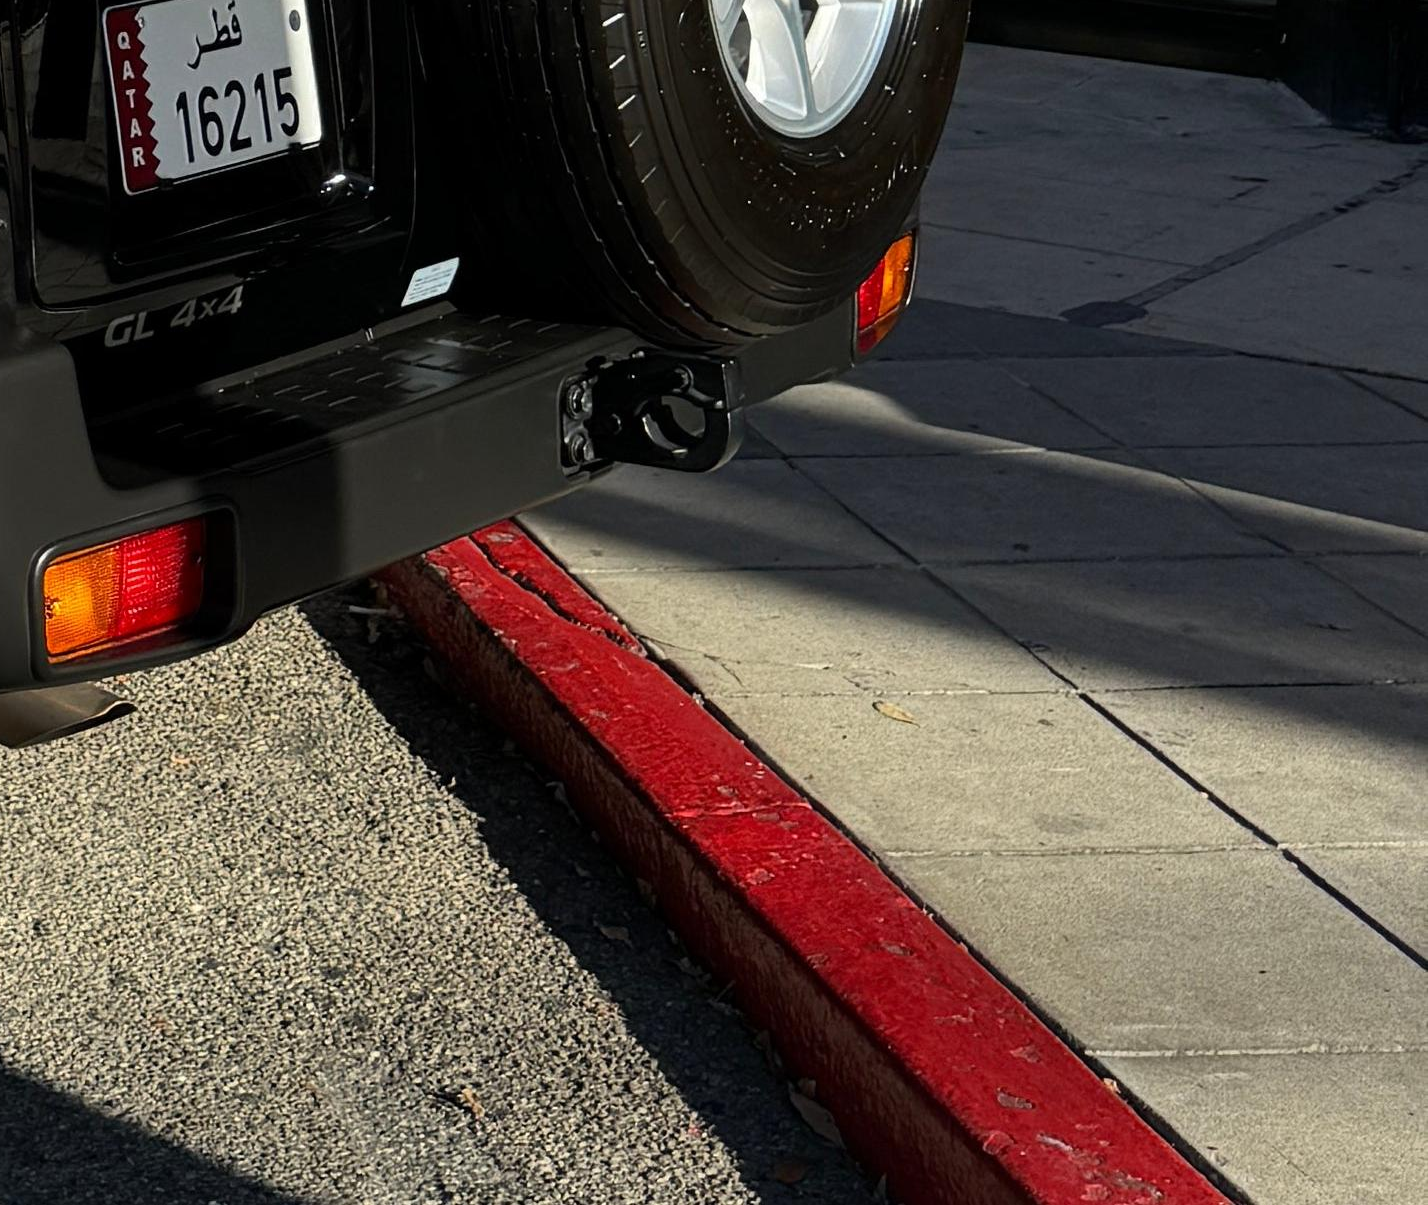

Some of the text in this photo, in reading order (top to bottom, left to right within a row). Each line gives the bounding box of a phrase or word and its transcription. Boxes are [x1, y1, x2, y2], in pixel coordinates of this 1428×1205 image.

[186, 0, 243, 70] قطر
[116, 31, 146, 168] QATAR
[175, 66, 301, 163] 16215
[104, 285, 244, 347] GL 4x4
